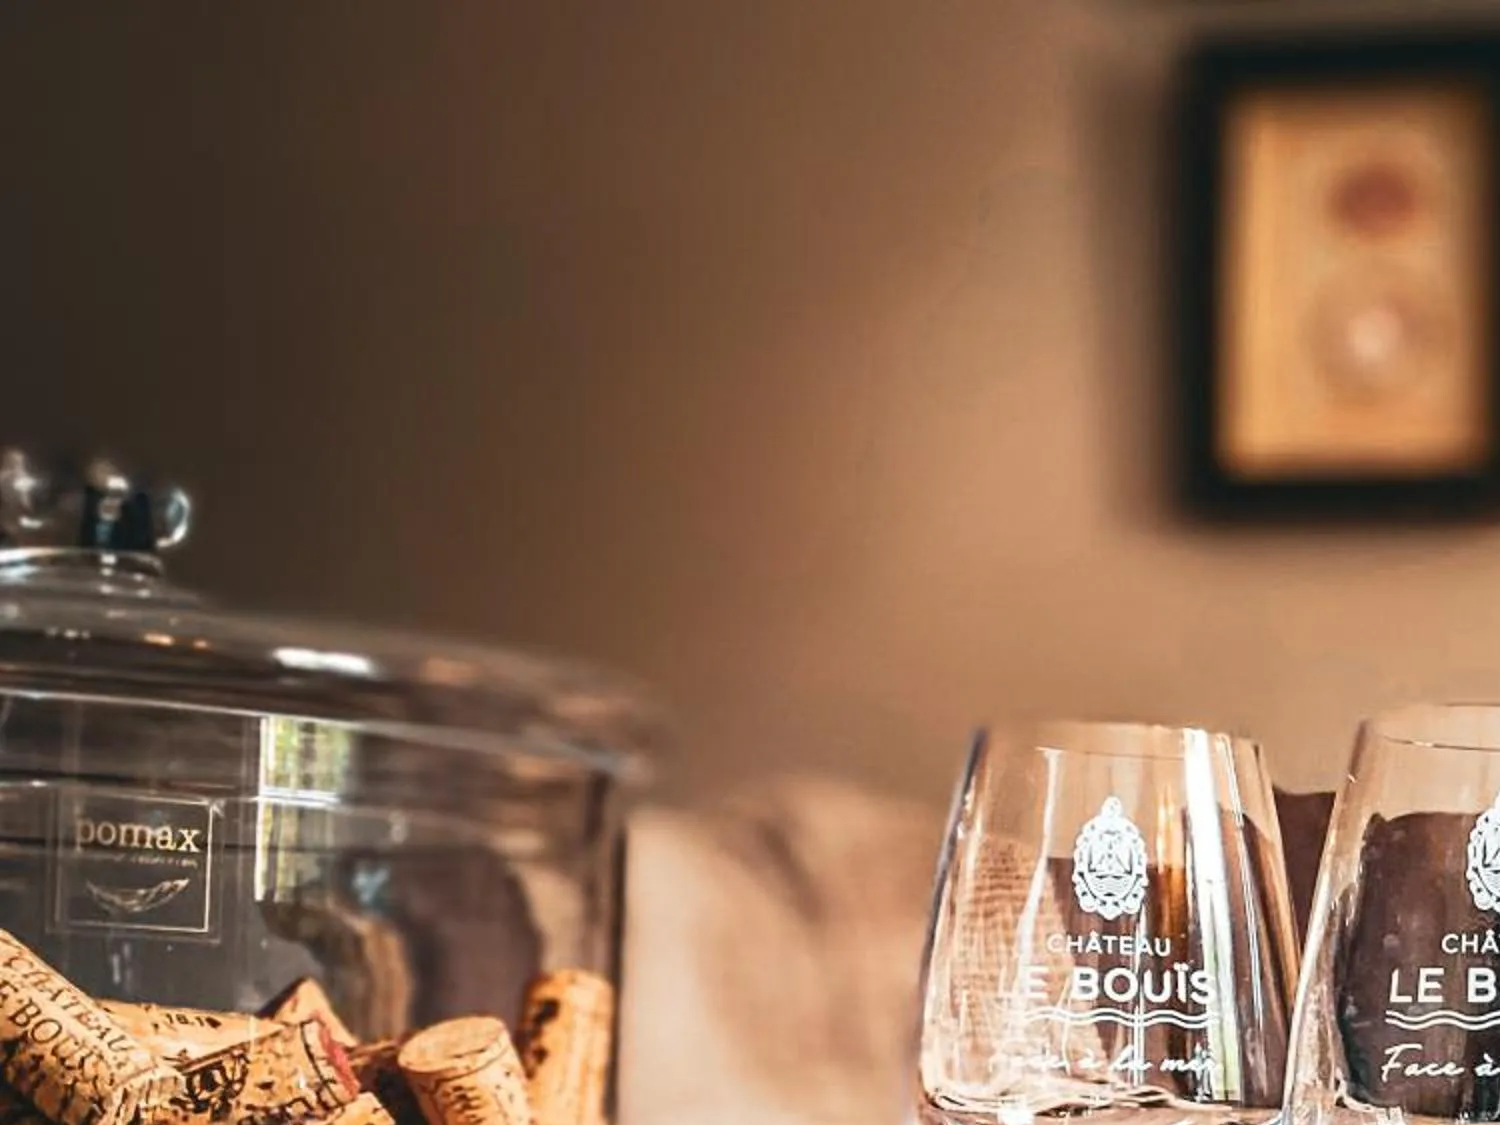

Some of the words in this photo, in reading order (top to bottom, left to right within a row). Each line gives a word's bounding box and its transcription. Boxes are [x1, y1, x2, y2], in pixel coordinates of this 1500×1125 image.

[75, 818, 201, 854] pomax
[1047, 931, 1172, 957] CHÂTEAU
[1072, 962, 1217, 1005] BOUÏS
[1389, 967, 1445, 1004] LE
[1381, 1043, 1464, 1083] Face
[1474, 1052, 1500, 1077] à
